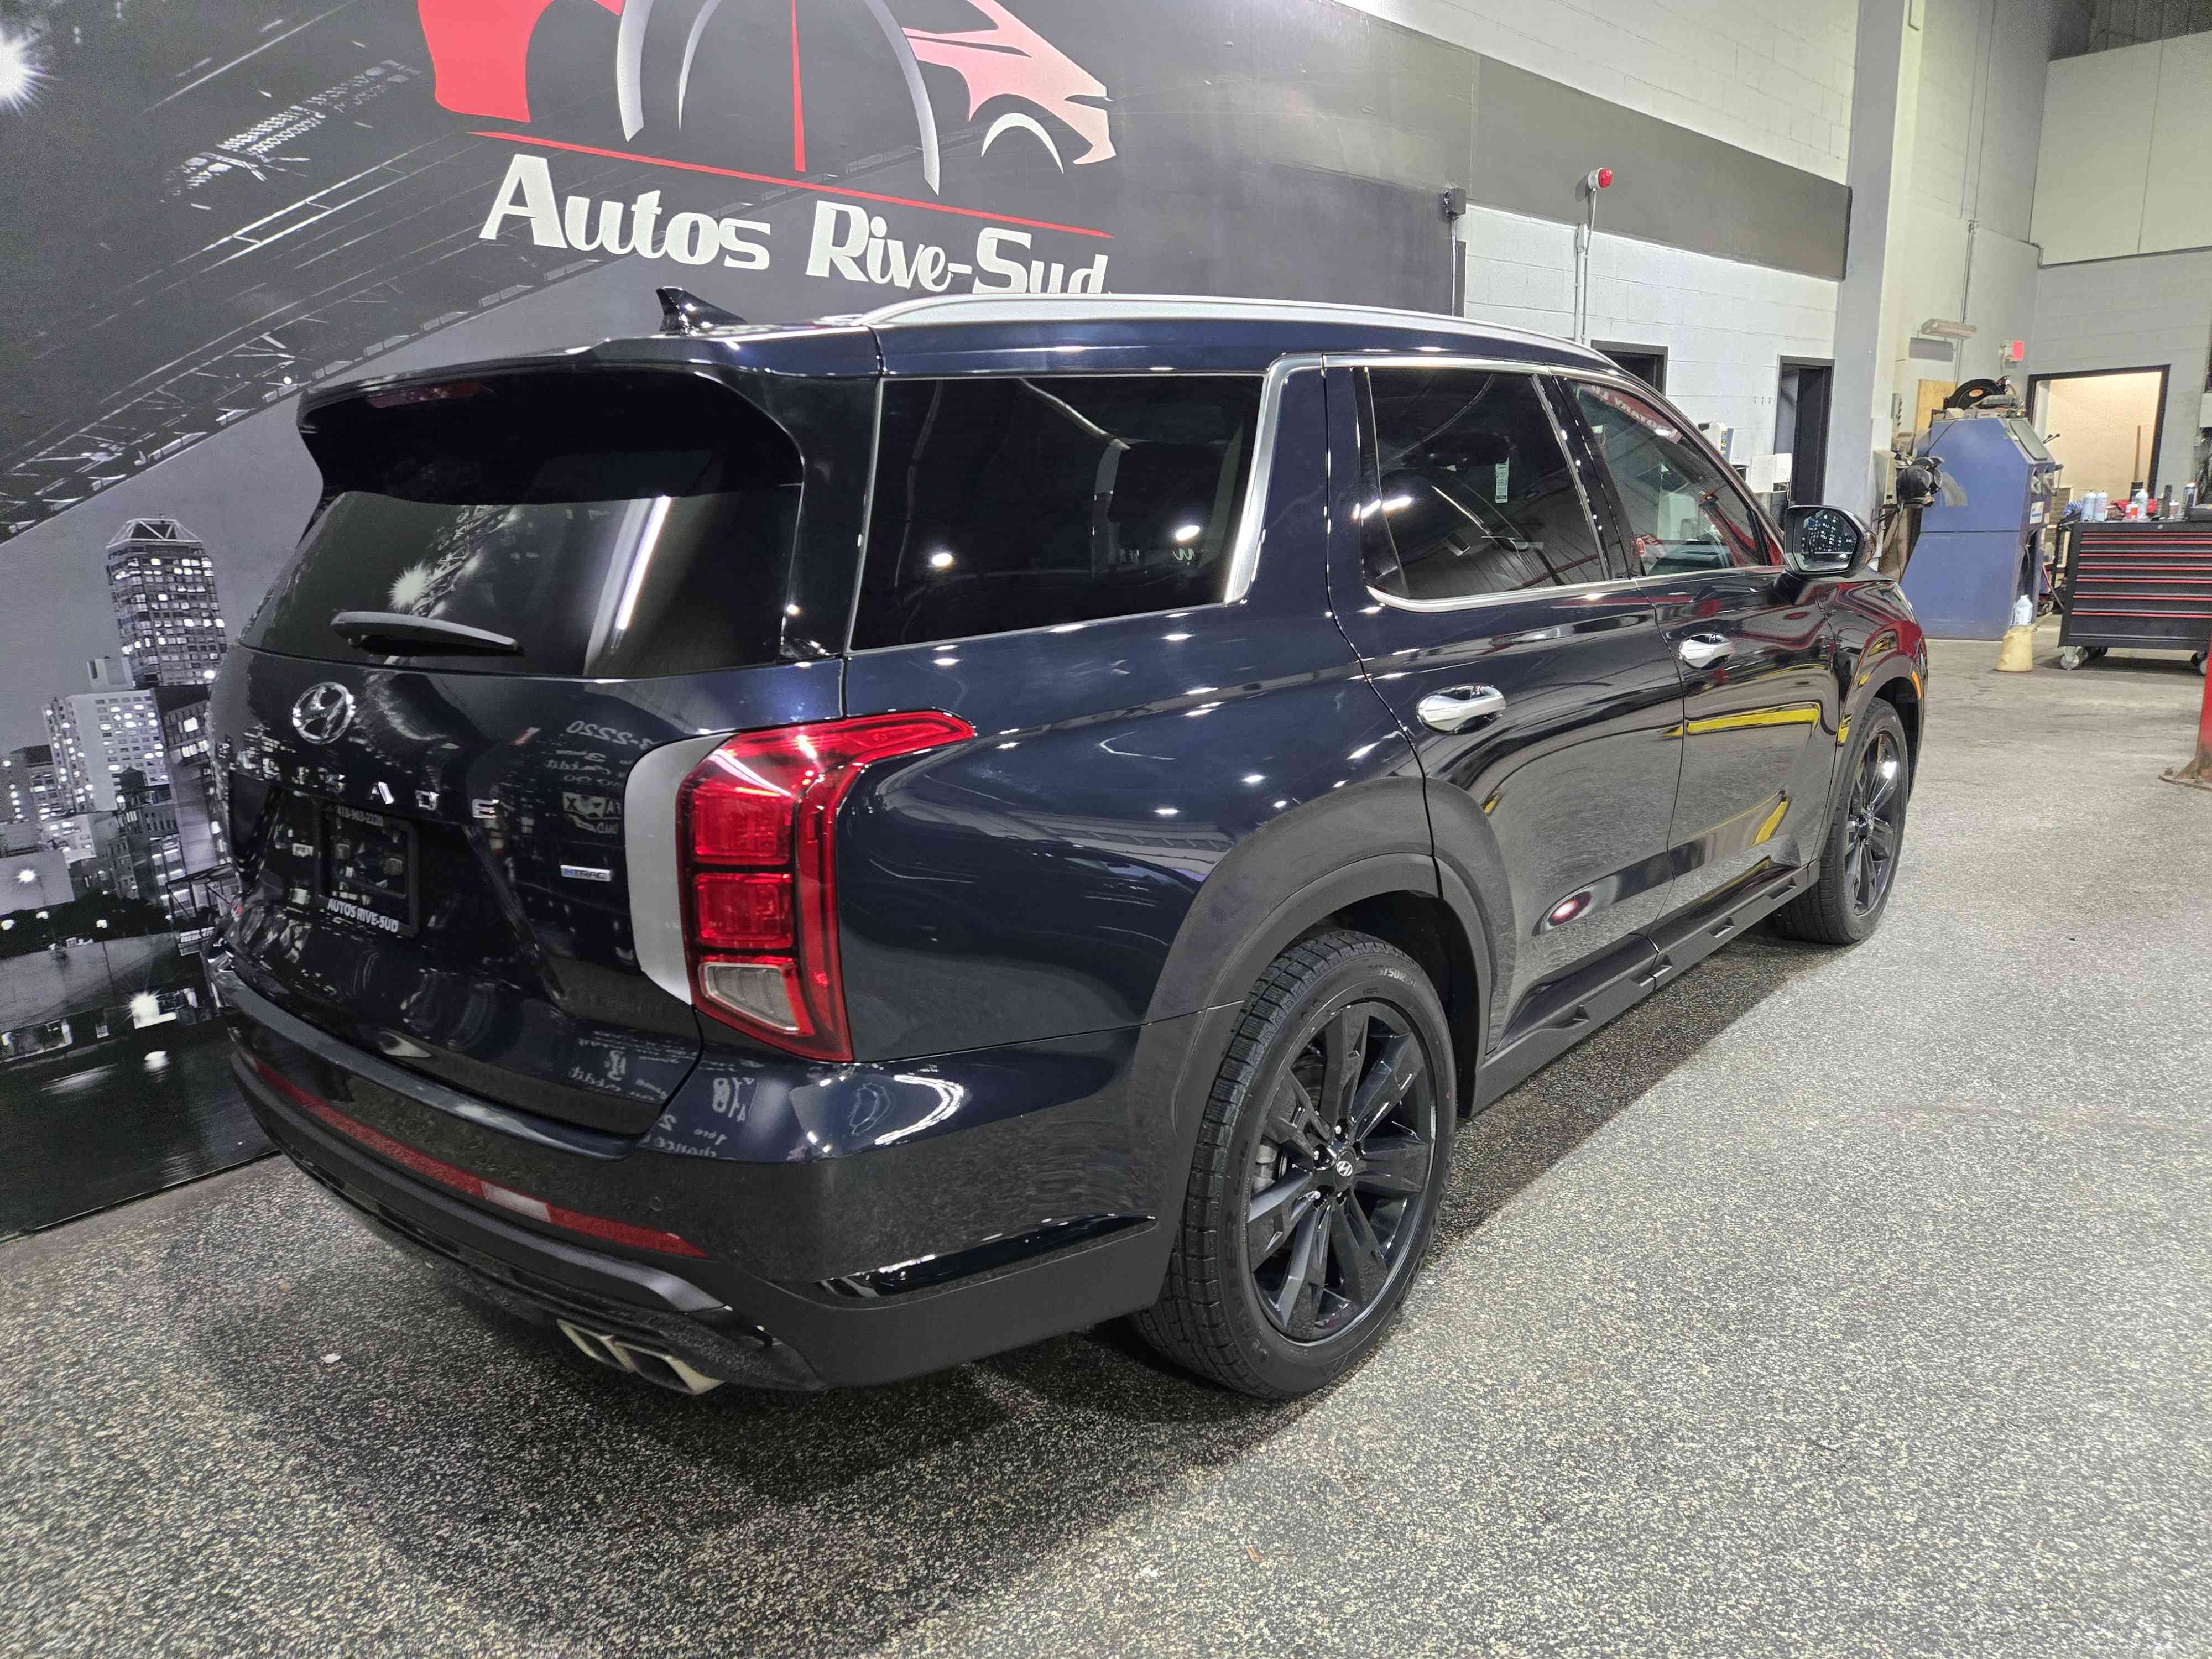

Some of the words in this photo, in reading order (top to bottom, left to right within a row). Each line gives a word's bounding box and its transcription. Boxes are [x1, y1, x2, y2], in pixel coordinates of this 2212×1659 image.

[479, 154, 771, 270] Autos
[806, 200, 1109, 294] Rive-Sud
[327, 898, 357, 918] AUTOS
[357, 907, 399, 933] RIVE-SUD
